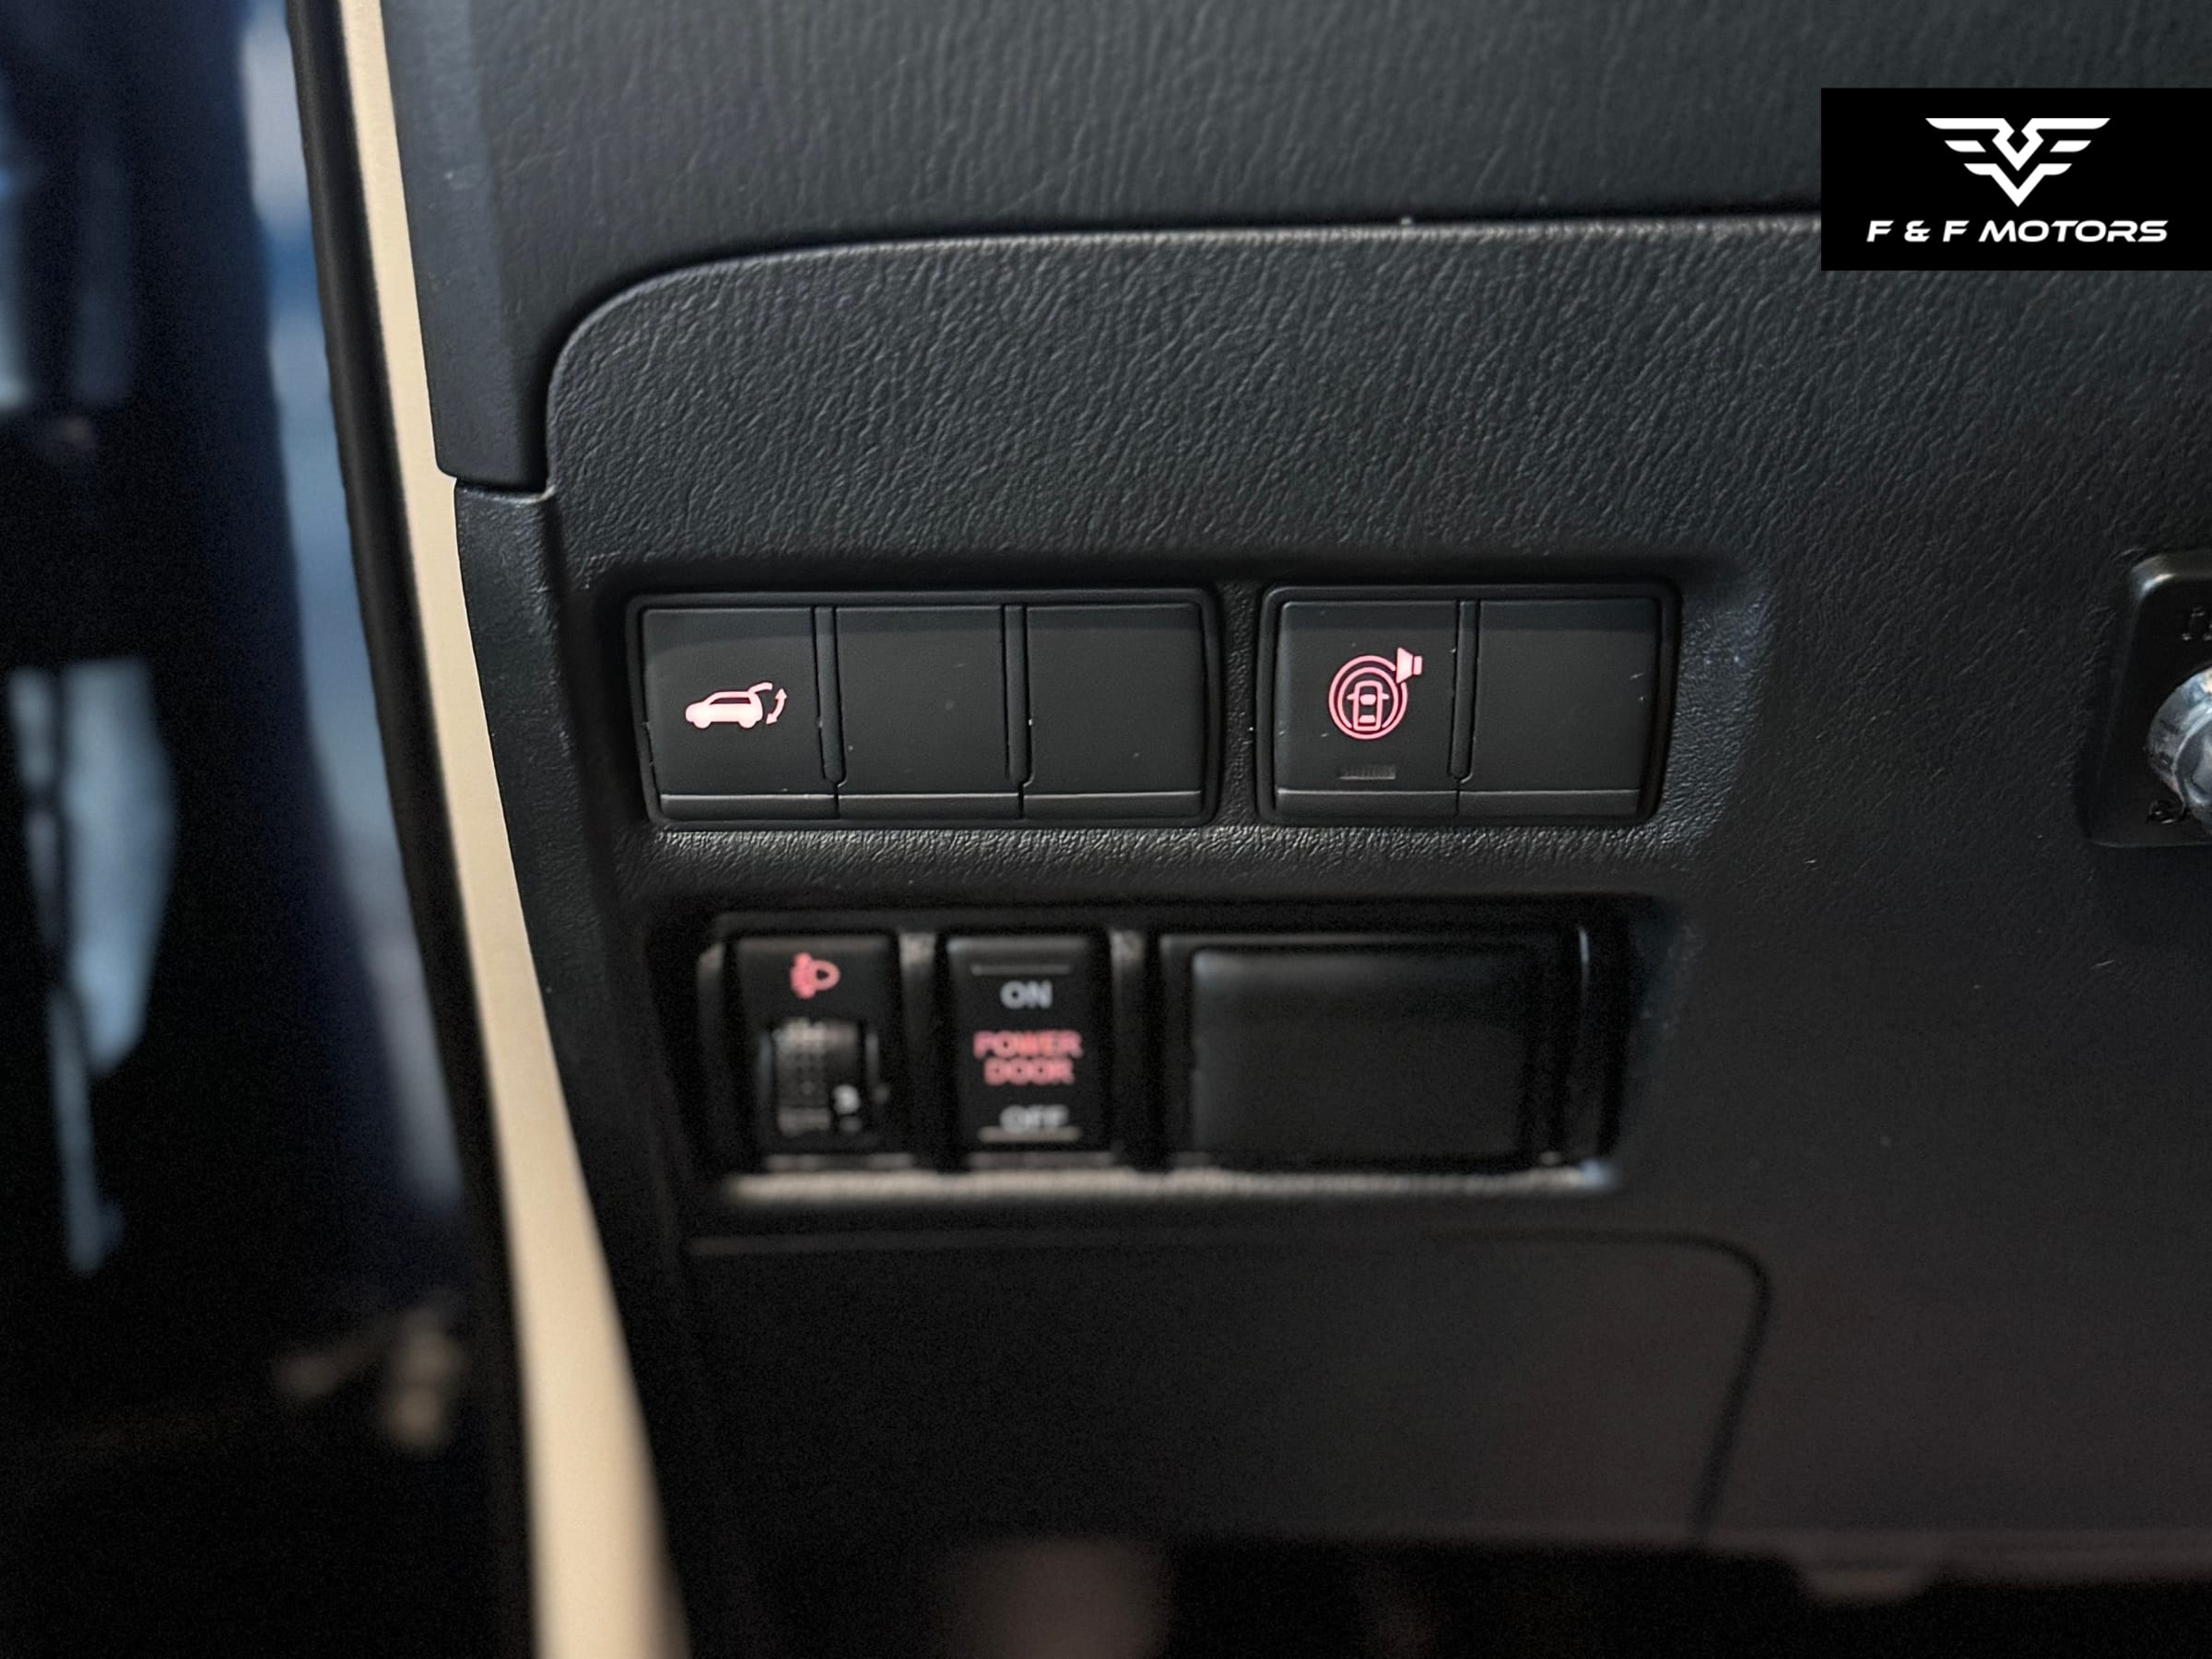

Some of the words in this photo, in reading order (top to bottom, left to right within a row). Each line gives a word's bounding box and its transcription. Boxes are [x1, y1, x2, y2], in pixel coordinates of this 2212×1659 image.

[1000, 980, 1053, 1009] ON
[973, 1030, 1082, 1059] POWER
[983, 1059, 1074, 1086] DOOR
[1000, 1104, 1069, 1134] OFF
